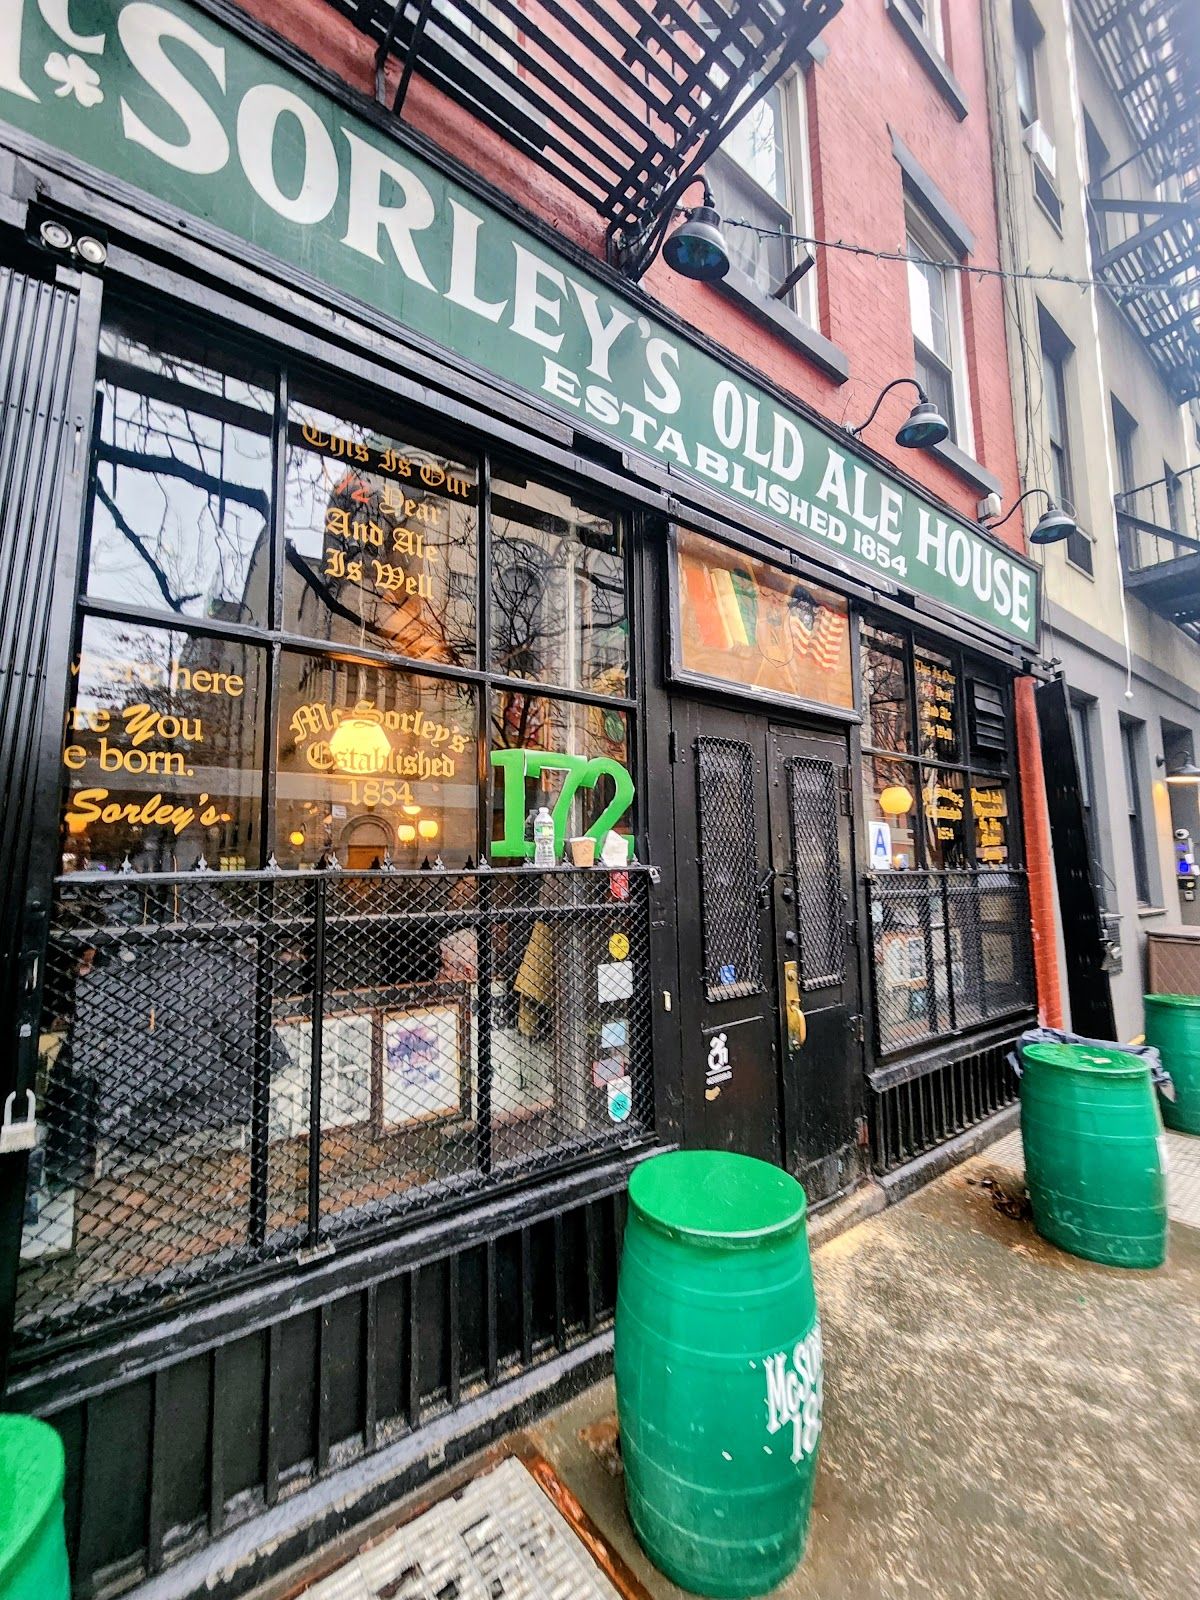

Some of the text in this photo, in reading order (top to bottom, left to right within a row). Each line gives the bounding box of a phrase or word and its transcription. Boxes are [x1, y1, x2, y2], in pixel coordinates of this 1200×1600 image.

[302, 423, 474, 499] This Is Our
[541, 355, 908, 578] ESTABLISHED 1854
[712, 380, 805, 482] OLD
[815, 447, 903, 546] ALE
[915, 507, 1031, 633] HOUSE
[325, 506, 440, 564] And Ale
[324, 546, 435, 600] Is Well
[171, 658, 244, 697] here
[122, 703, 204, 747] You
[99, 737, 194, 777] born.
[348, 779, 414, 807] 1854
[490, 748, 635, 858] 172
[874, 828, 887, 855] A
